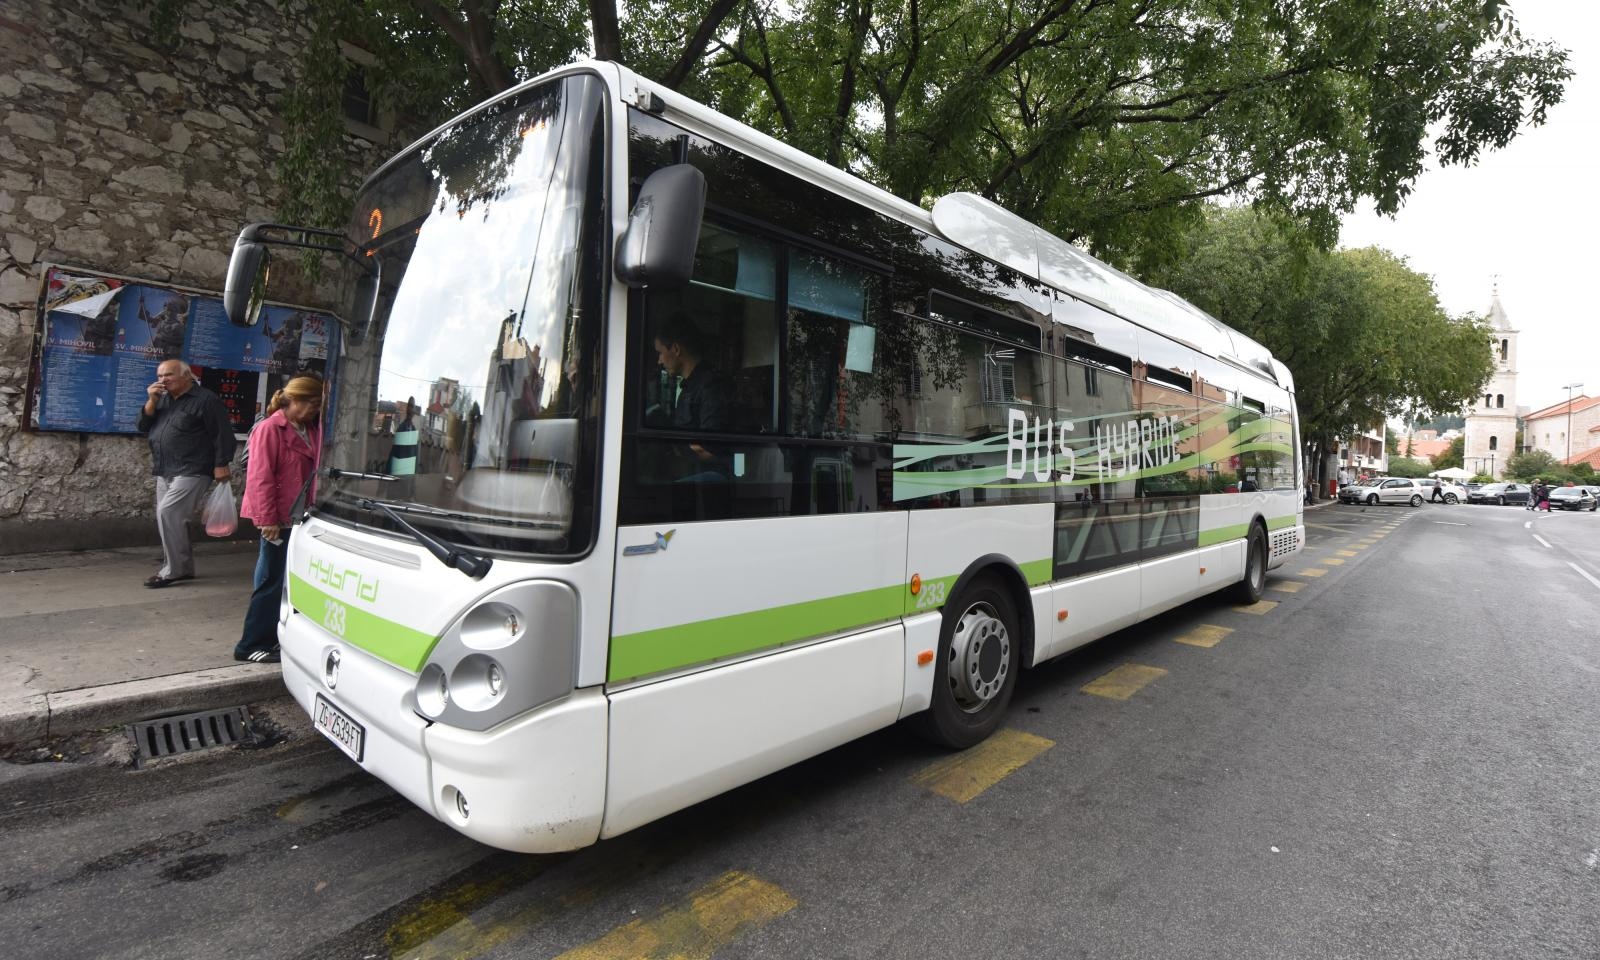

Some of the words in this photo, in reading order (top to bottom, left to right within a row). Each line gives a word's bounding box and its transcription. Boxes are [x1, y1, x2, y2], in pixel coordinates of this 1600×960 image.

[59, 338, 97, 349] MIHOVIL
[130, 345, 165, 353] MIHOVIL
[1006, 408, 1075, 483] BUS
[1096, 415, 1181, 482] HYBRIDE
[916, 582, 945, 608] 233
[324, 600, 346, 636] 233
